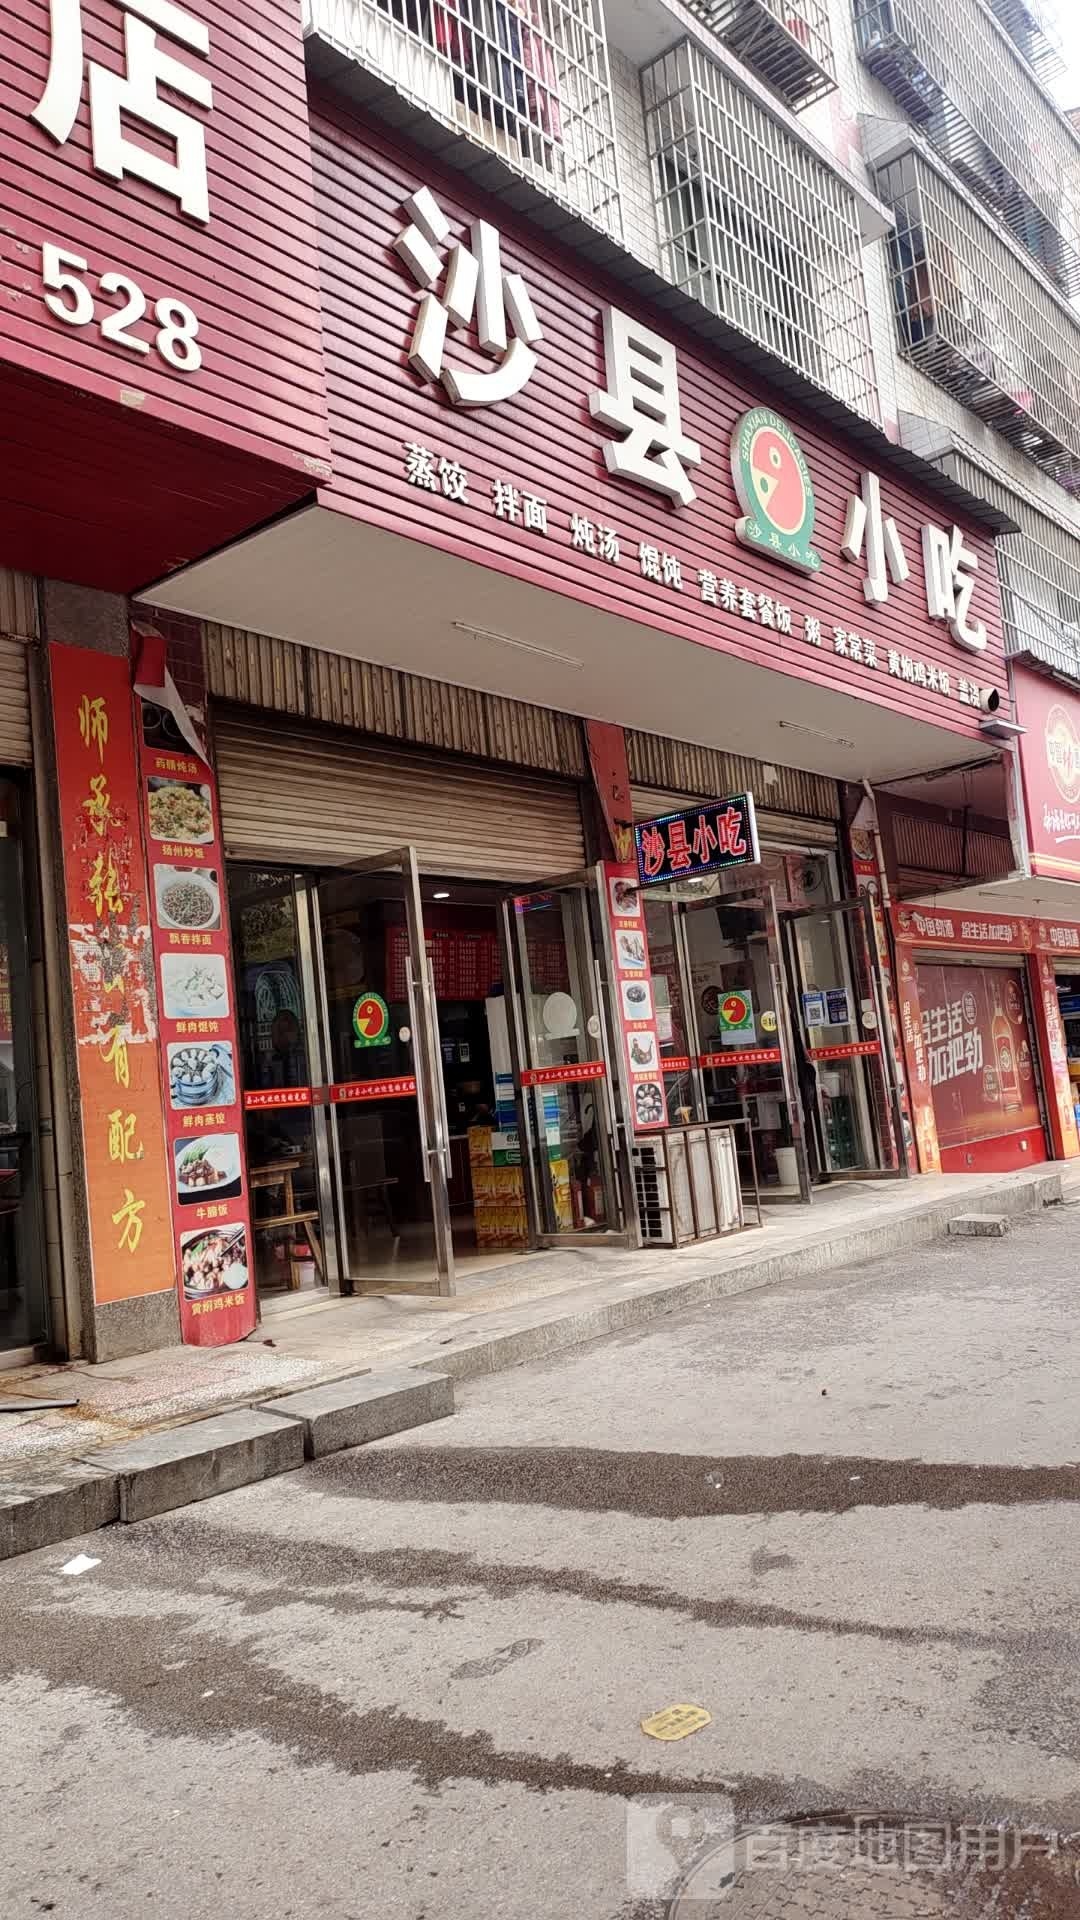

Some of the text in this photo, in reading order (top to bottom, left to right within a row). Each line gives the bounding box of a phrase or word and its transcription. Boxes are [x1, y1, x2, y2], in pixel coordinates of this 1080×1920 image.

[30, 0, 213, 224] 店
[42, 241, 203, 371] 528
[402, 441, 469, 504] 蒸饺
[491, 479, 548, 534] 拌面
[570, 512, 621, 564] 炖汤
[638, 541, 684, 590] 馄饨
[697, 567, 793, 636] 营养套餐饭
[803, 614, 822, 647] 粥
[832, 626, 878, 669] 家常菜
[887, 649, 950, 696] 黄焖鸡米饭
[747, 521, 820, 569] 沙县小吃
[640, 806, 747, 877] 沙县小吃
[960, 921, 1013, 943] 给生活加把劲
[927, 1027, 984, 1086] 加把劲
[182, 1112, 226, 1129] 鲜肉蒸饺
[195, 1205, 229, 1219] 牛腩饭
[191, 1293, 246, 1316] 黄焖鸡米饭
